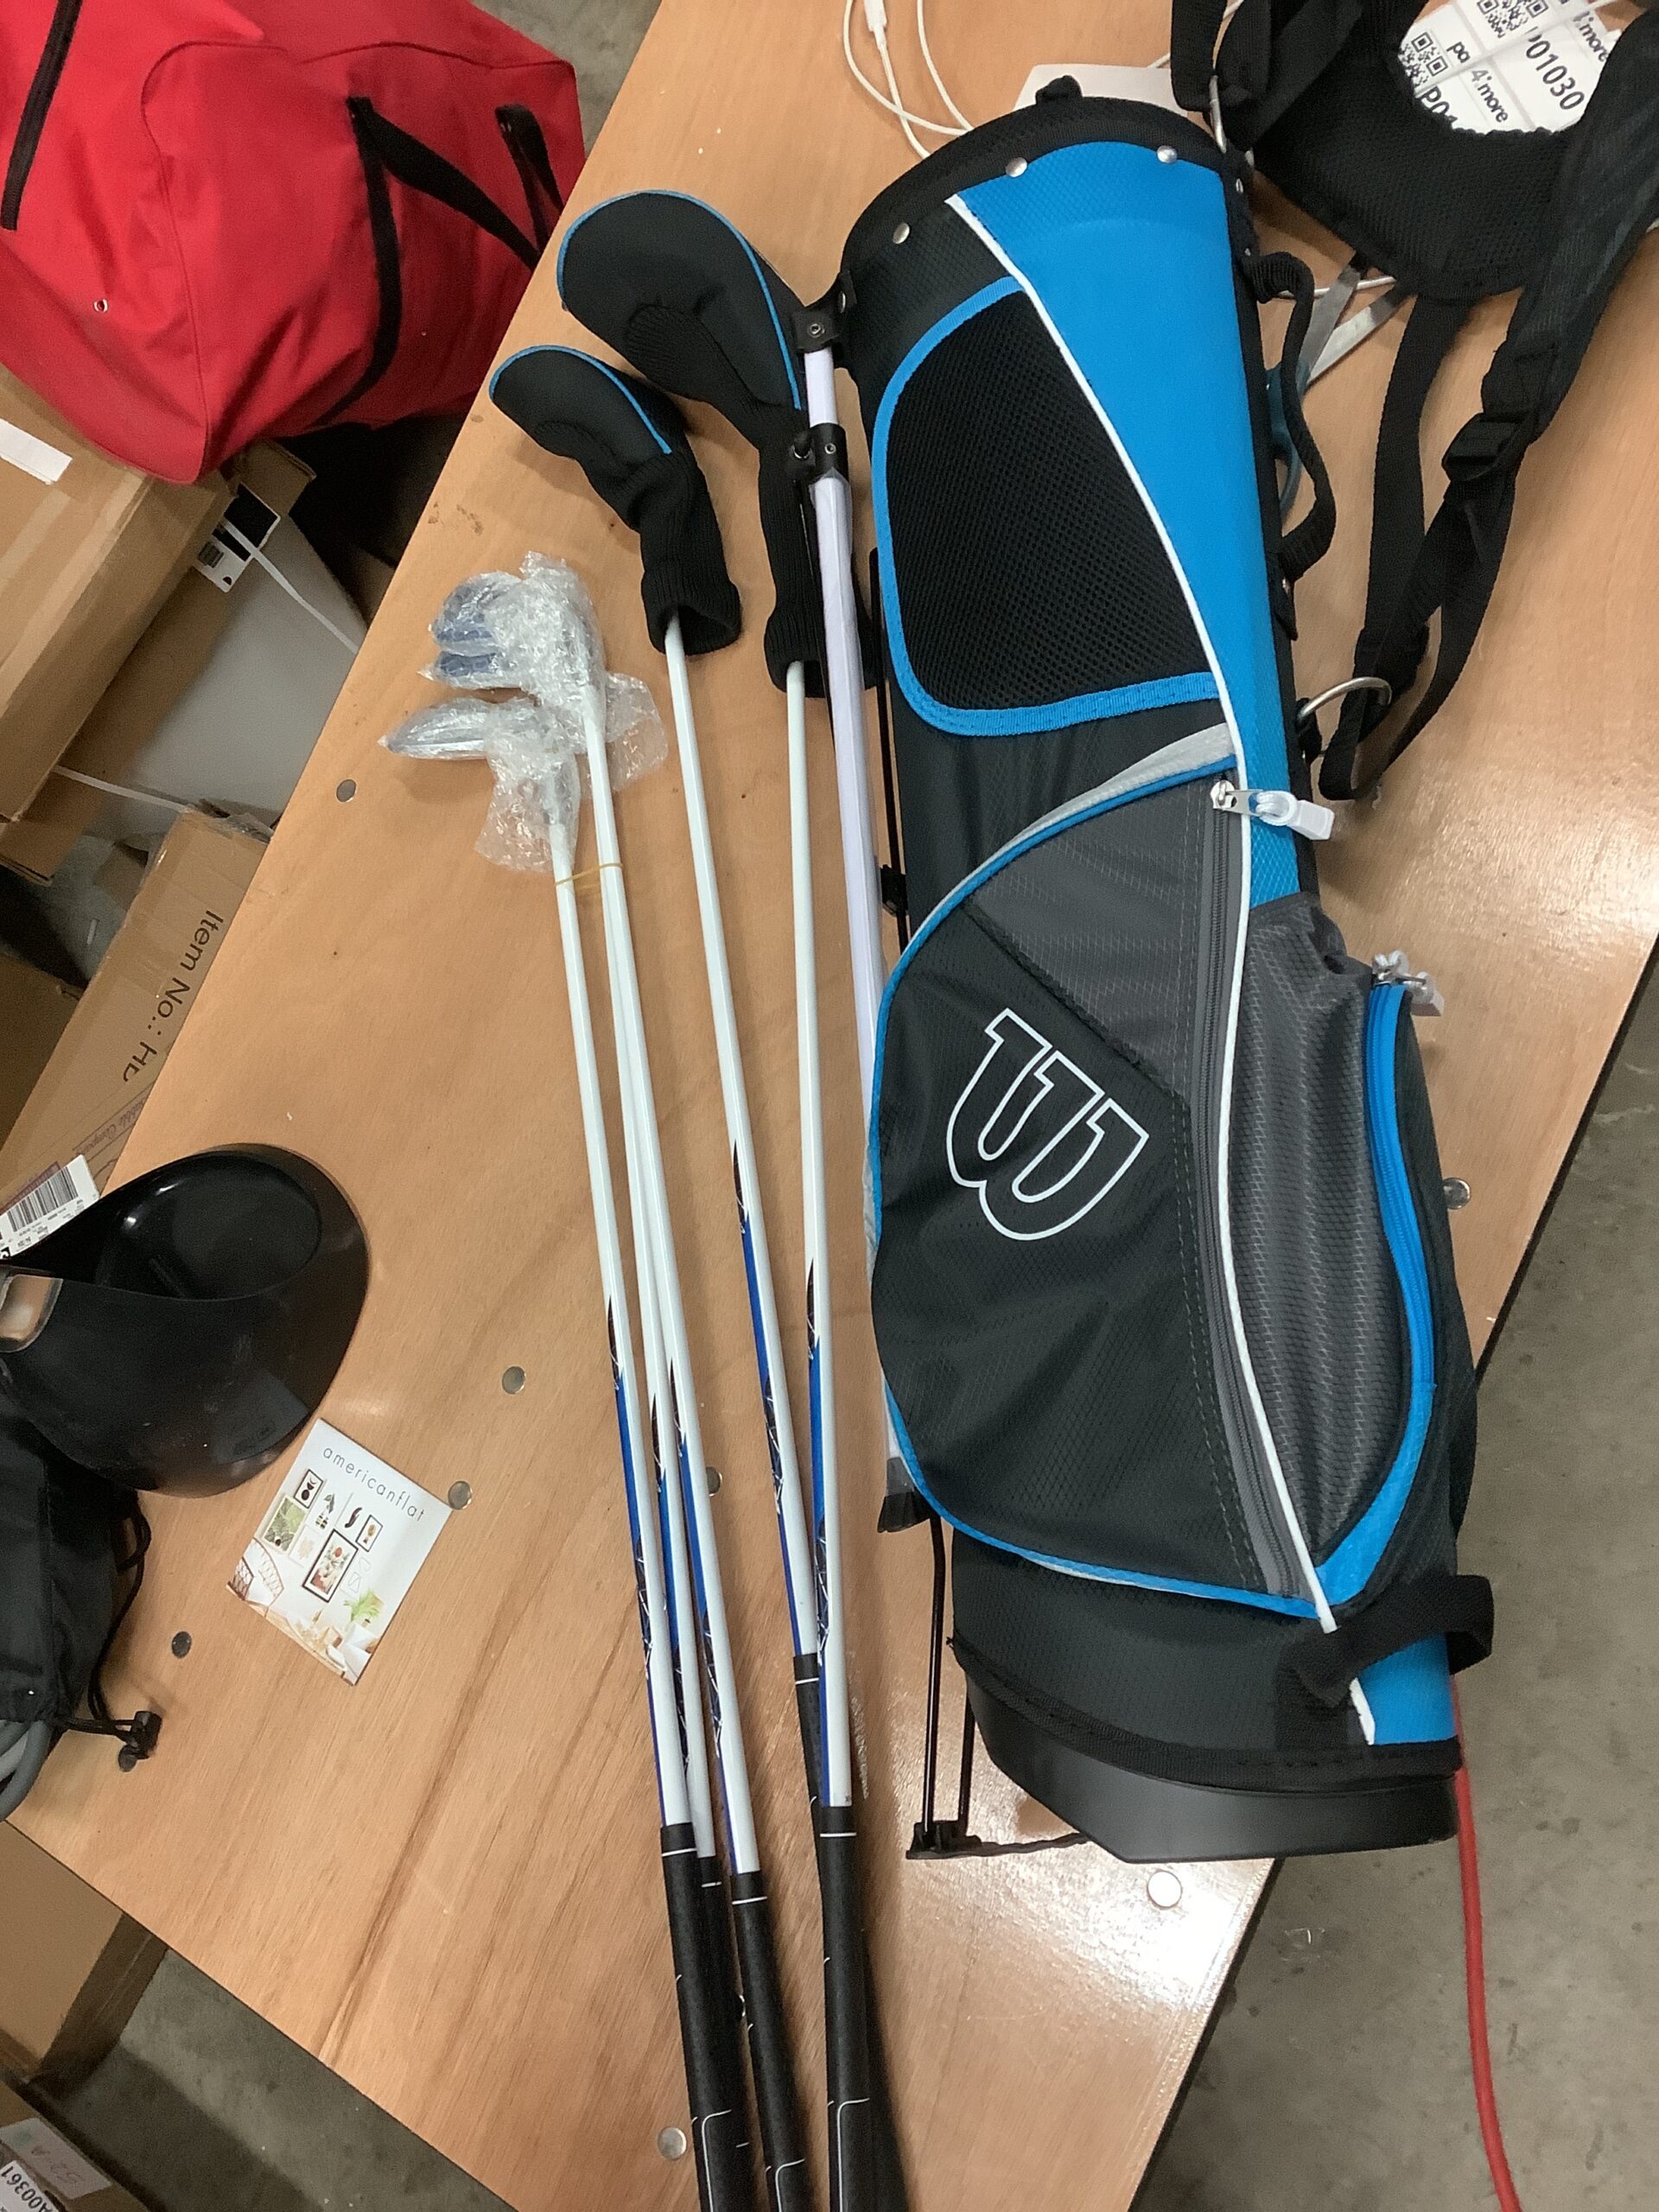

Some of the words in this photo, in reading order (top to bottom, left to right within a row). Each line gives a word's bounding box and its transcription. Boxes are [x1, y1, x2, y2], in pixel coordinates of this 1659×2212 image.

[1525, 26, 1586, 110] 01030
[180, 910, 225, 971] Item
[322, 1446, 426, 1522] americanflat
